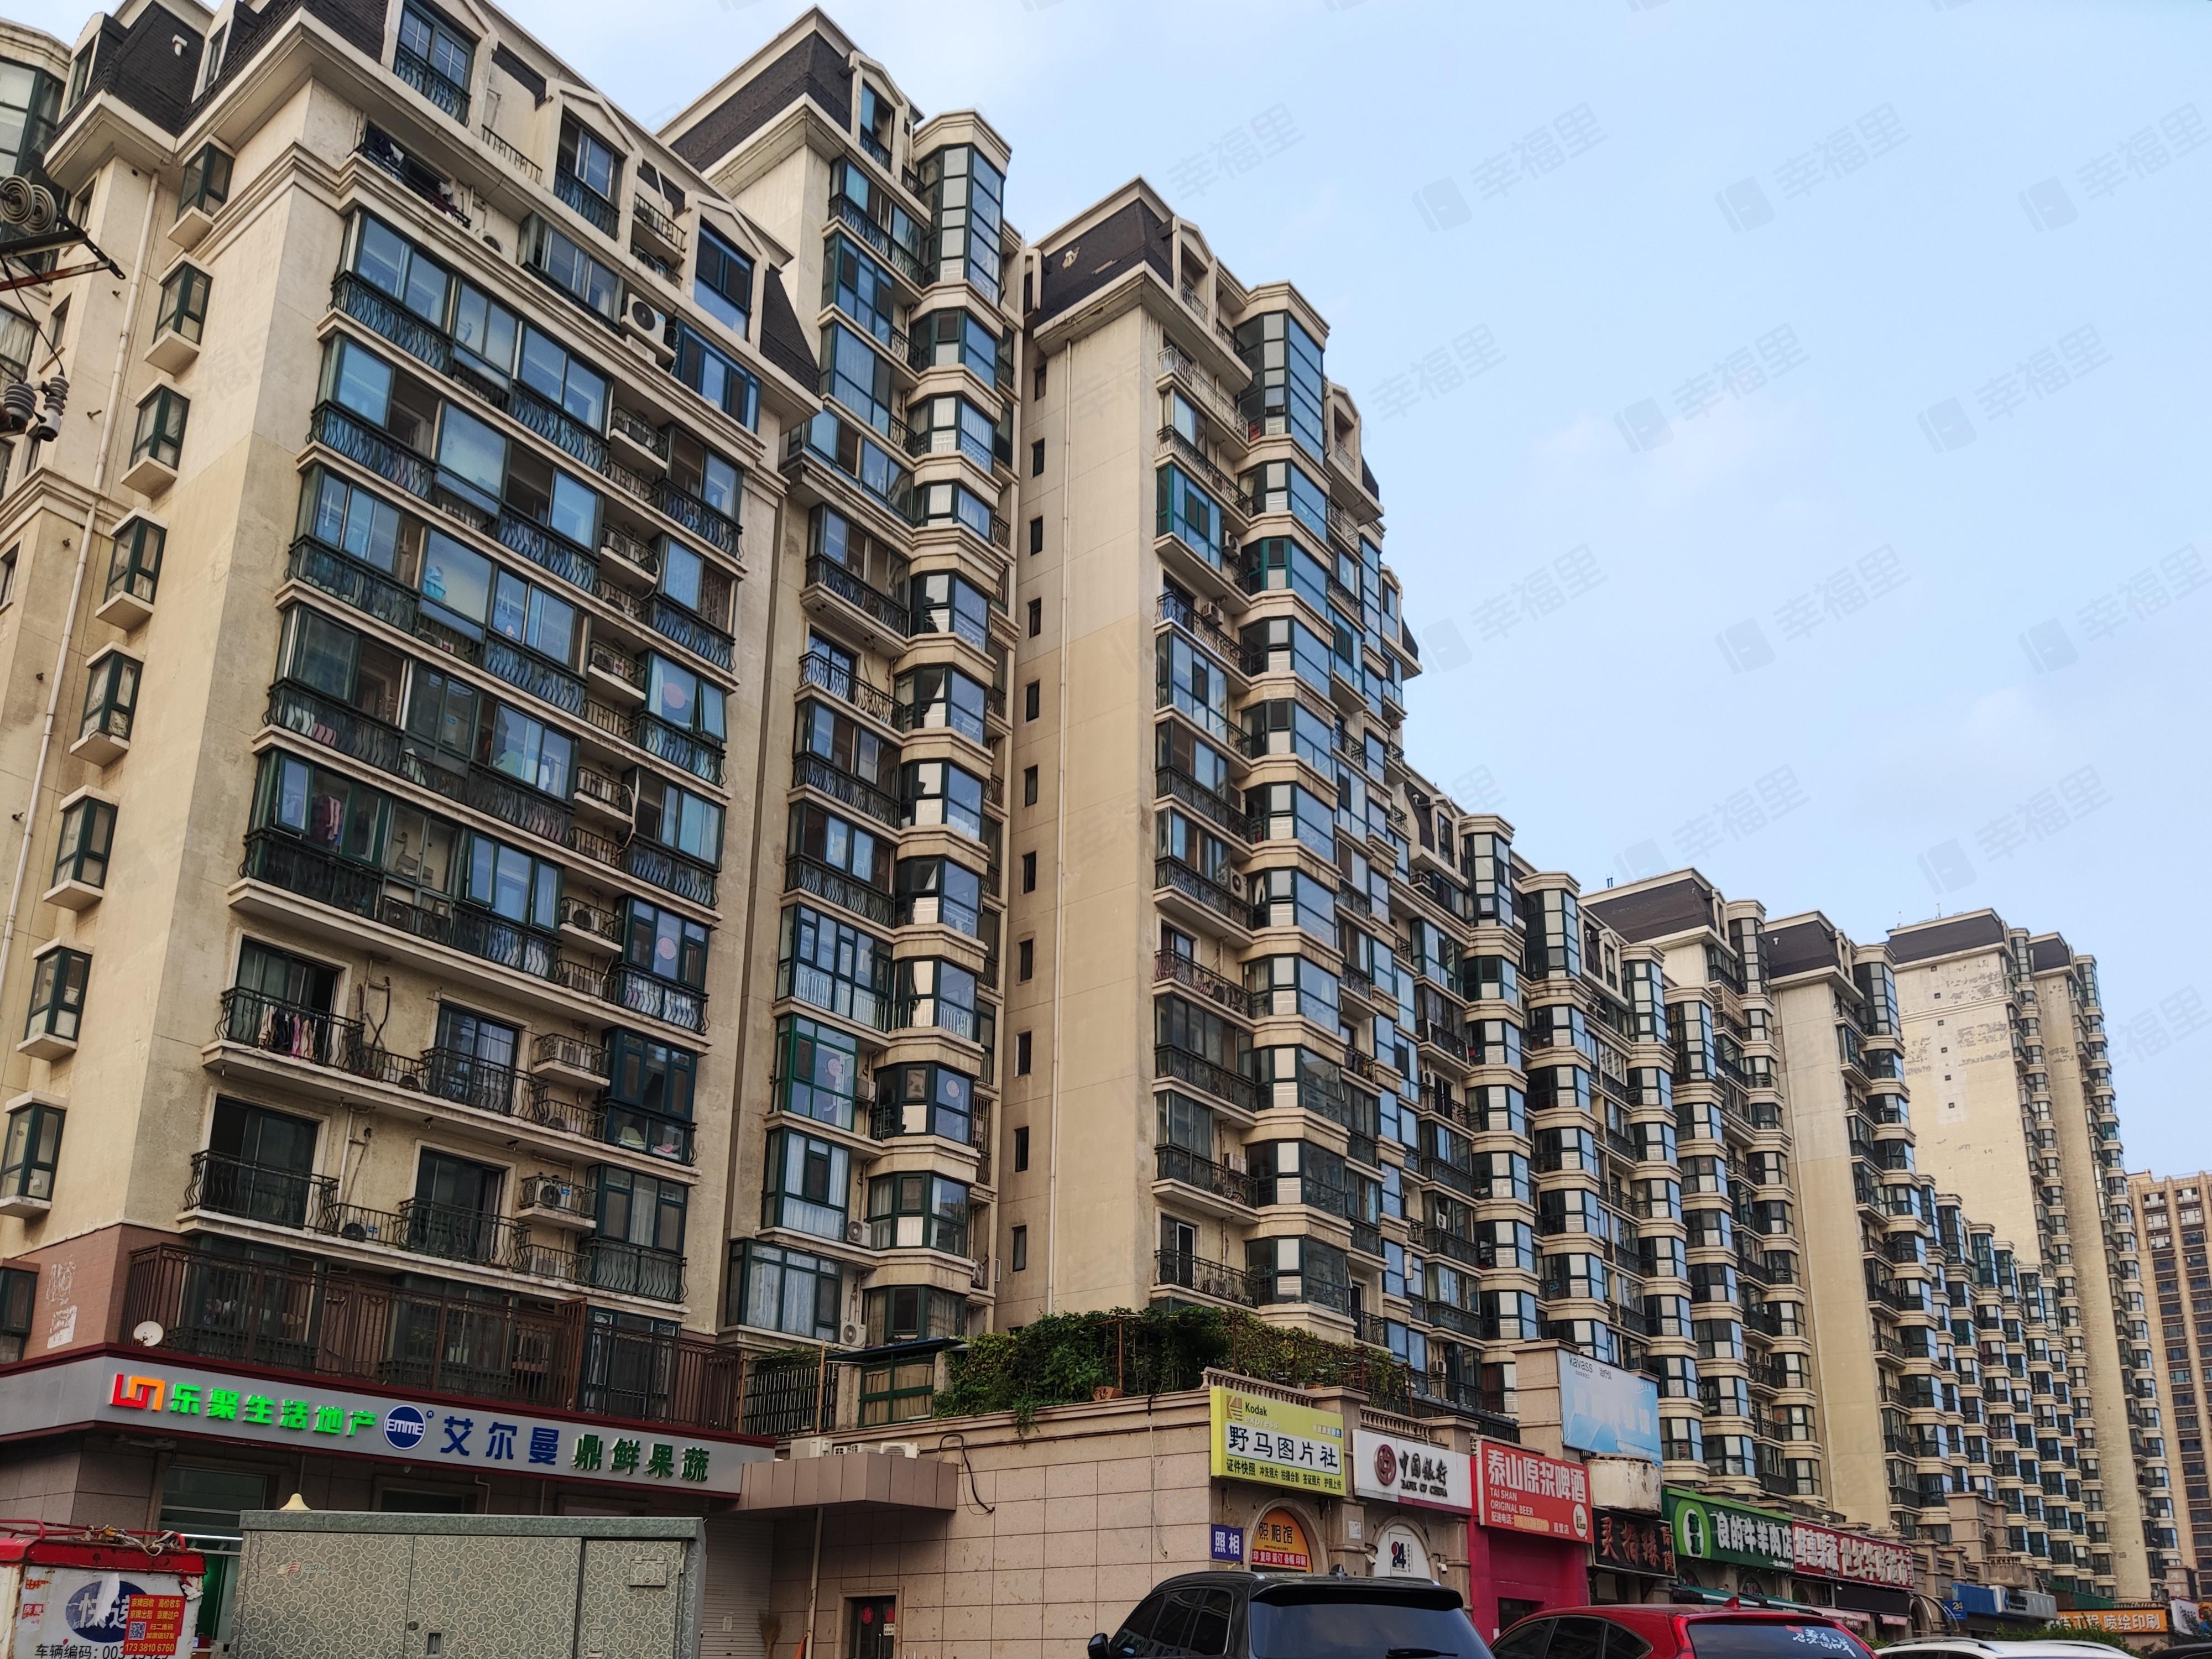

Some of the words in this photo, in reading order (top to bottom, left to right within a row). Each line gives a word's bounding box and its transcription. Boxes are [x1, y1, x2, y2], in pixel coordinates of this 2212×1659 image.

[1569, 1354, 1593, 1373] kavass
[169, 1384, 377, 1436] 乐聚生活地产
[1245, 1402, 1267, 1416] Kodak
[386, 1418, 424, 1436] EMME
[1245, 1416, 1279, 1430] express
[440, 1416, 560, 1465] 艾尔曼
[1229, 1425, 1338, 1468] 野马图片社
[571, 1433, 709, 1481] 鼎鲜果蔬
[1226, 1458, 1256, 1476] 证件快照
[1399, 1450, 1448, 1486] 中国银行
[1401, 1479, 1417, 1491] BANK
[1488, 1449, 1587, 1504] 泰山原浆啤酒
[1490, 1487, 1500, 1498] TAI
[1501, 1489, 1517, 1501] SHAN
[1490, 1500, 1519, 1514] ORIGINAL
[1519, 1504, 1533, 1516] BEER
[1259, 1522, 1293, 1544] 照相馆
[1215, 1531, 1240, 1555] 照相
[2103, 1613, 2160, 1630] 喷绘印刷
[125, 1642, 138, 1652] 173
[139, 1643, 155, 1652] 3810
[157, 1644, 174, 1652] 6760
